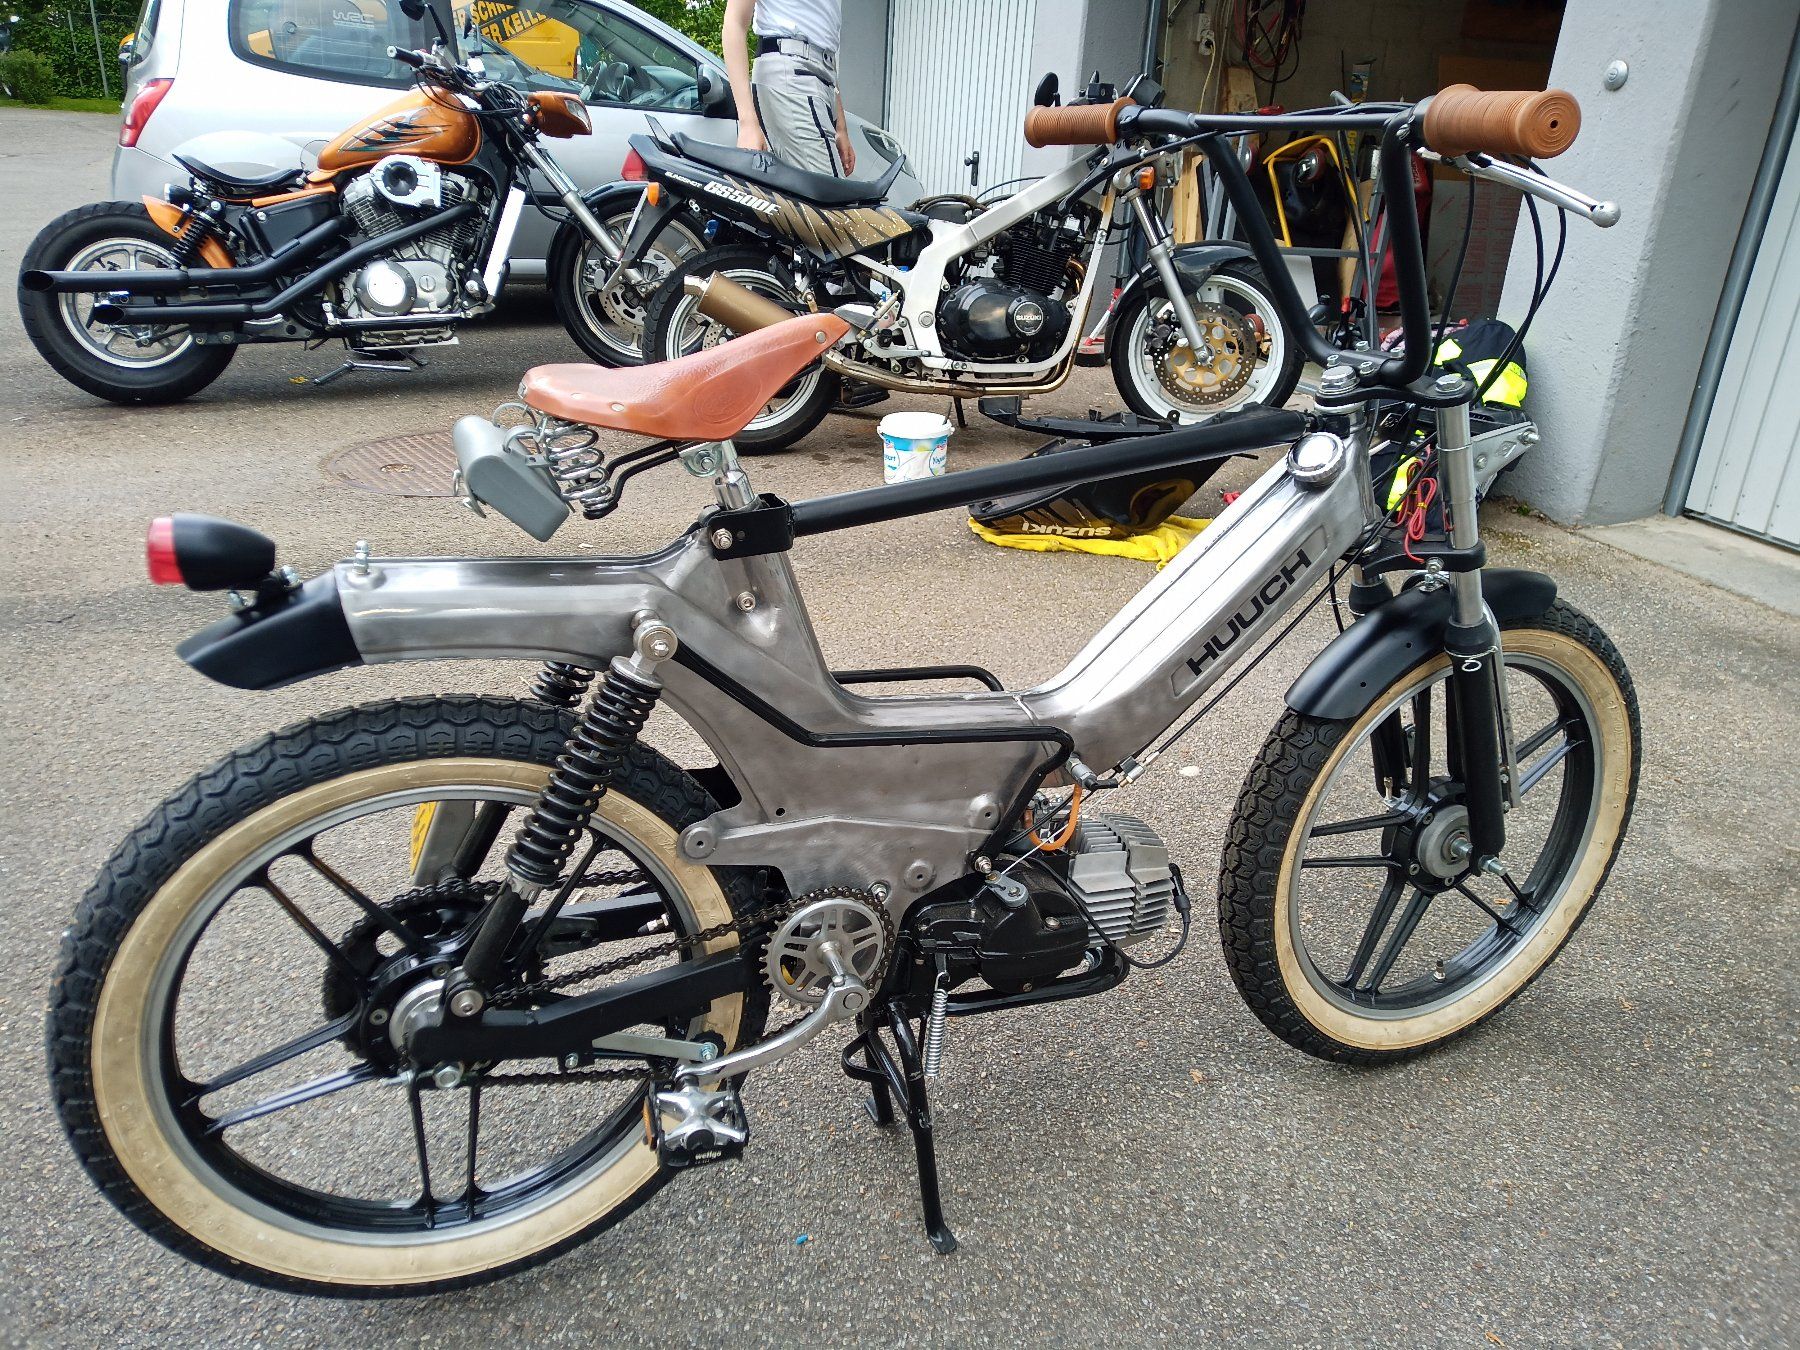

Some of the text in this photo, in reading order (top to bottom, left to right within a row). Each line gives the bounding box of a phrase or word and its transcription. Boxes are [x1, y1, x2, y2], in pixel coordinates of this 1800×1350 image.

[704, 181, 781, 216] GS500E
[1021, 522, 1112, 537] SUZUKI
[1186, 548, 1312, 676] HUUCH
